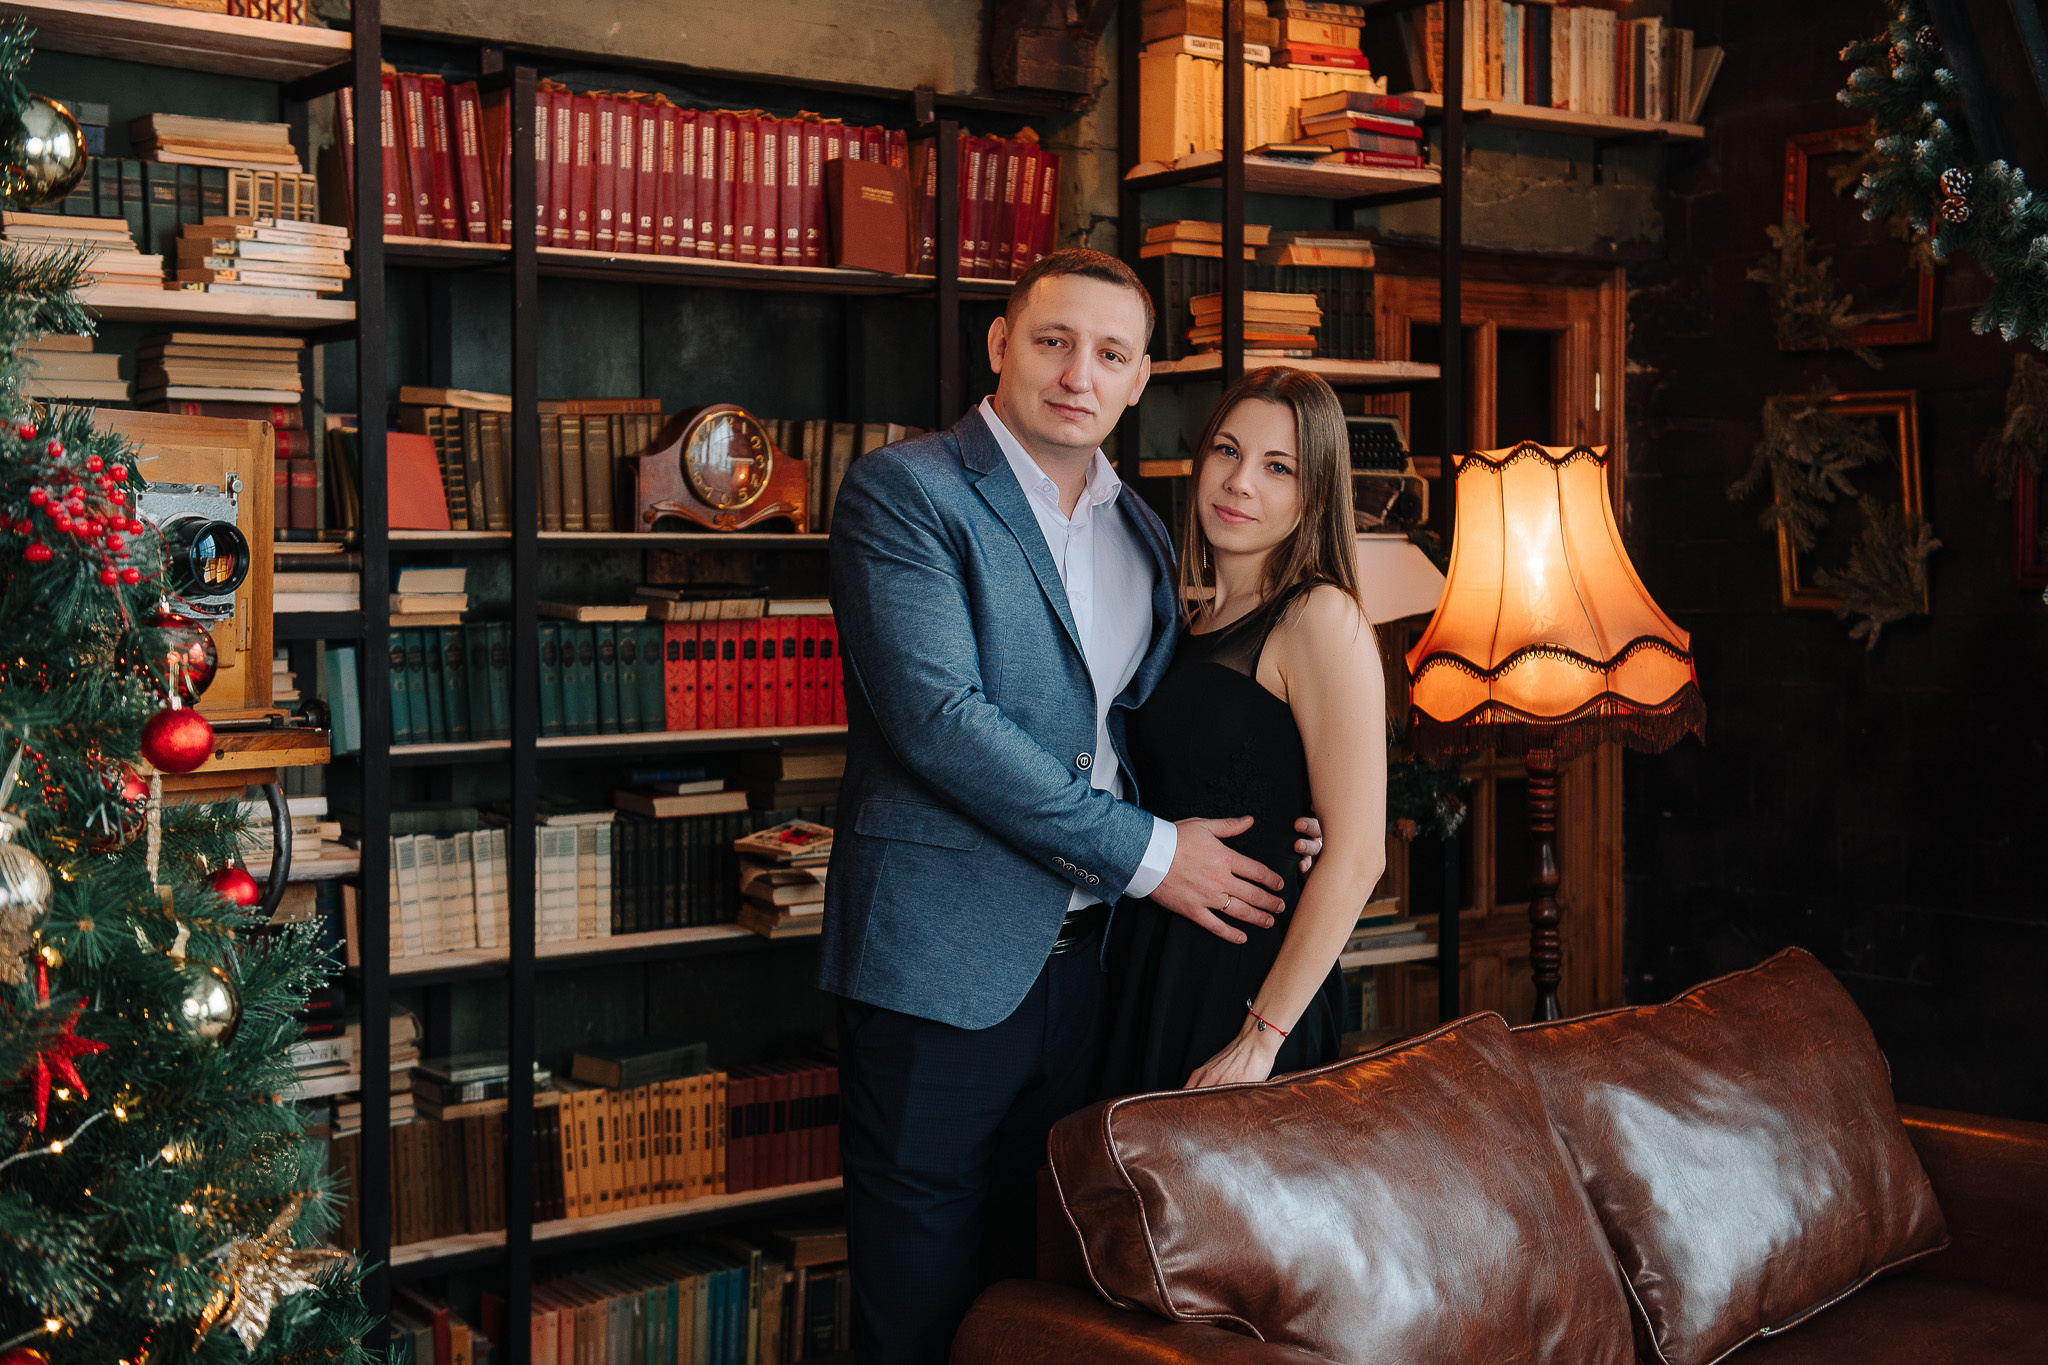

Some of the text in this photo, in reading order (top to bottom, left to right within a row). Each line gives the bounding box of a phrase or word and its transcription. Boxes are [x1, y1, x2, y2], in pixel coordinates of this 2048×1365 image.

[386, 192, 397, 207] 2
[419, 192, 429, 206] 3
[471, 201, 480, 214] 5
[536, 205, 544, 217] 7
[558, 208, 567, 221] 8
[578, 210, 587, 222] 9
[600, 208, 612, 221] 10
[621, 212, 632, 224] 11
[640, 215, 651, 228] 12
[663, 216, 673, 228] 13
[682, 218, 693, 230] 14
[701, 221, 713, 234] 15
[723, 224, 734, 237] 16
[743, 225, 754, 237] 17
[787, 227, 799, 240] 19
[963, 239, 975, 251] 26
[741, 420, 747, 435] 1
[750, 435, 761, 449] 2
[755, 454, 765, 469] 3
[693, 471, 703, 485] 8
[750, 473, 759, 487] 4
[704, 486, 713, 499] 7
[721, 492, 731, 505] 6
[738, 487, 748, 500] 5
